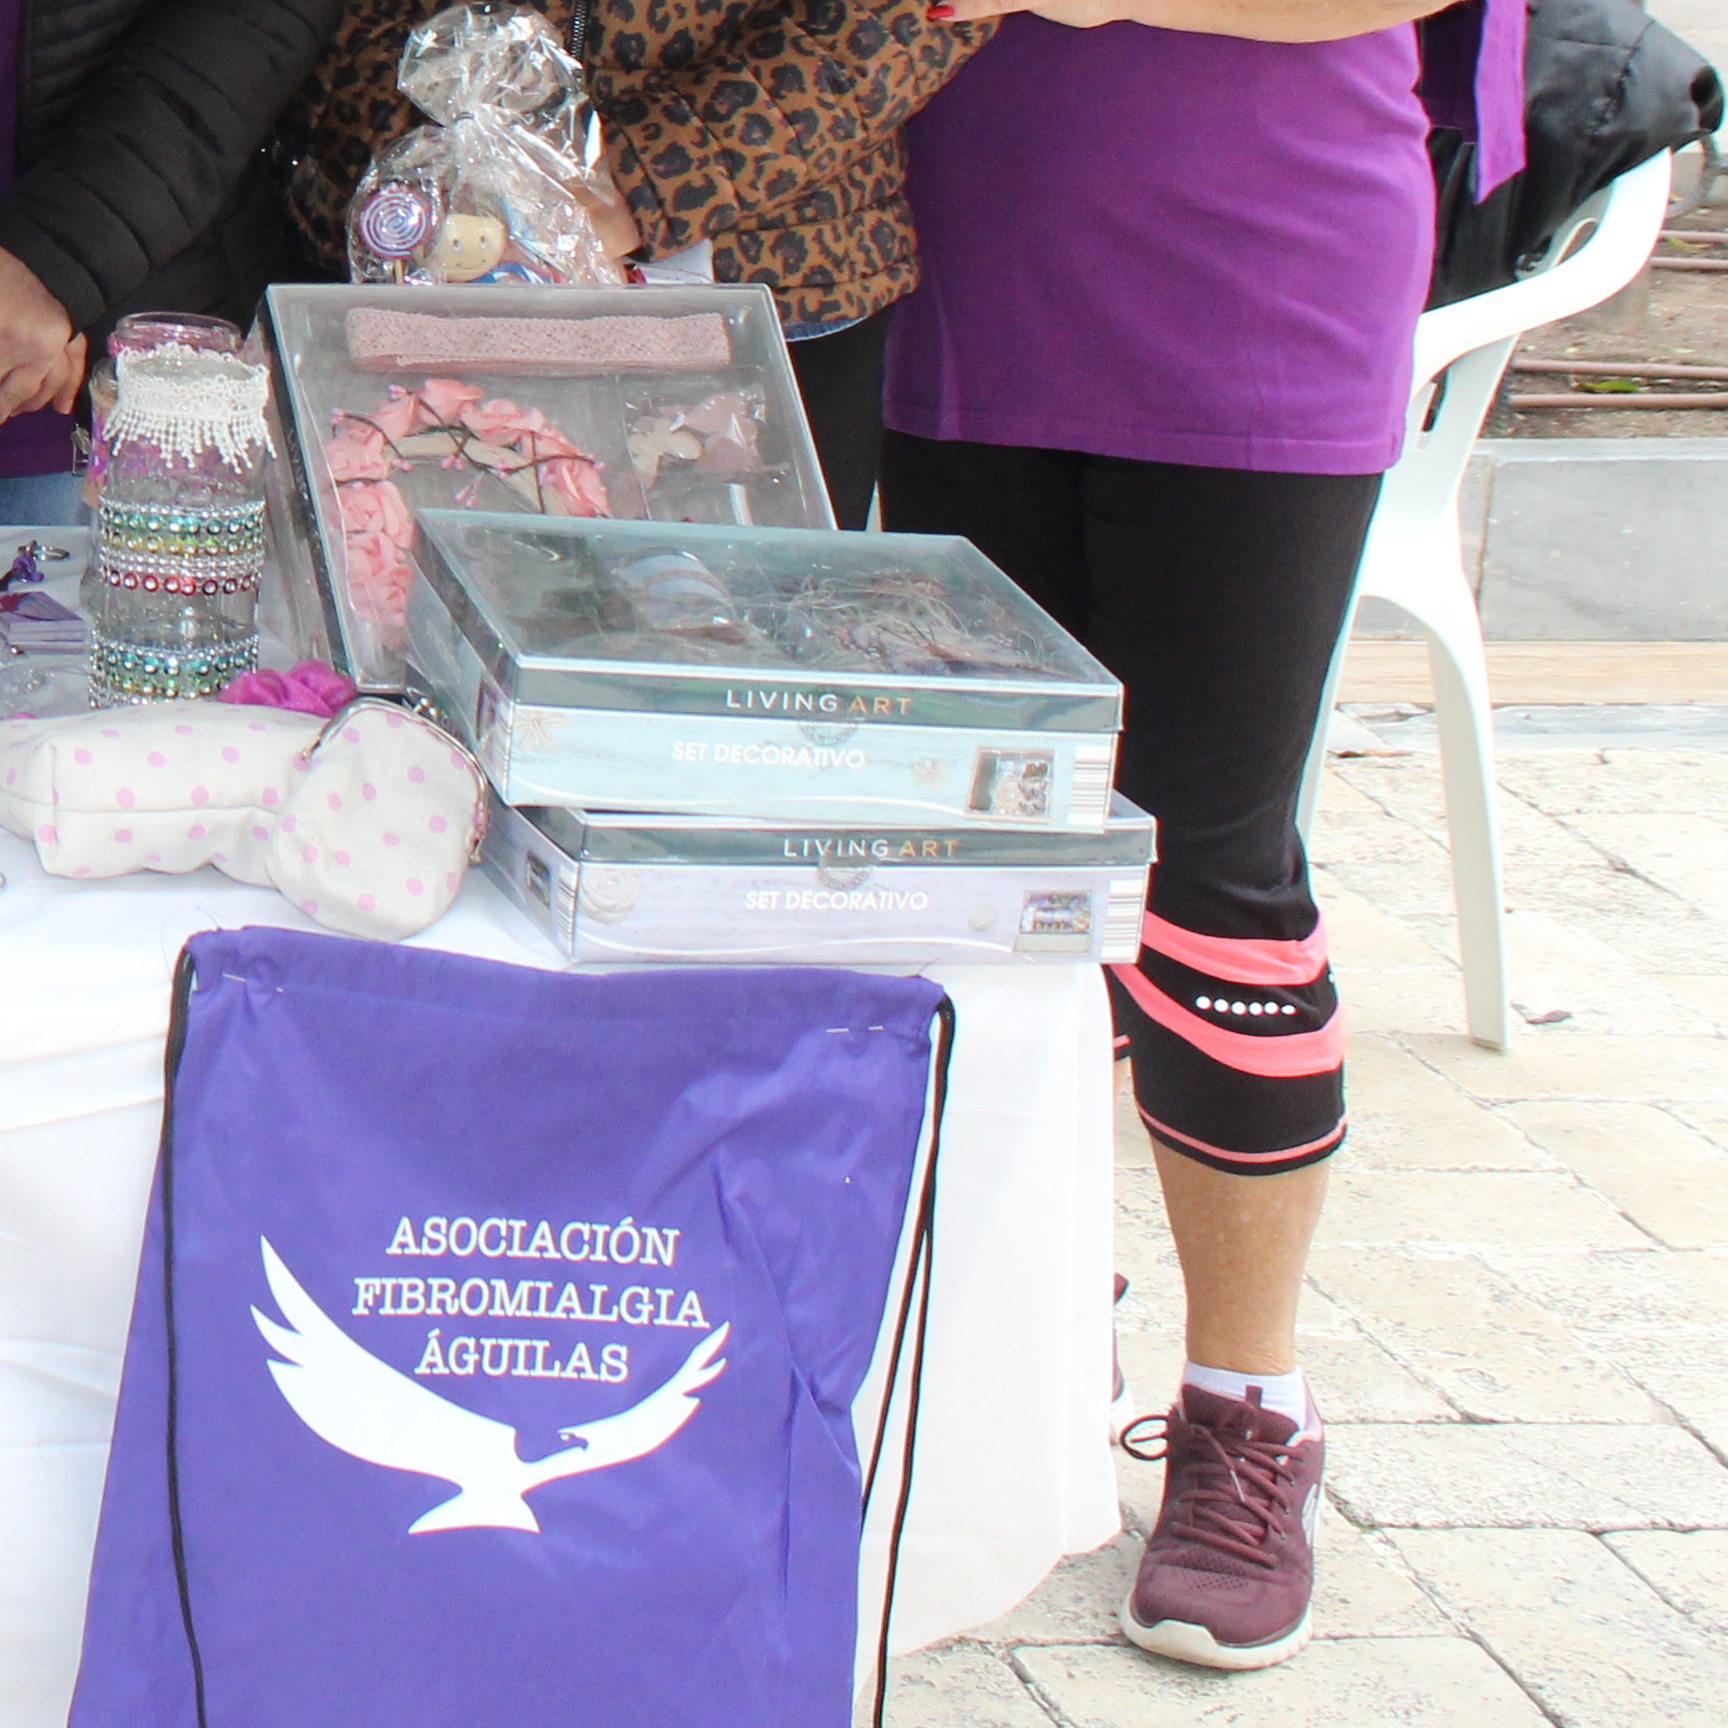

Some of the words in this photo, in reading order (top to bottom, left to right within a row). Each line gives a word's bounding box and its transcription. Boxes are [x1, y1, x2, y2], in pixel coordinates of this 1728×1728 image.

[725, 688, 839, 714] LIVING
[848, 695, 914, 717] ART
[672, 741, 709, 762] SET
[713, 742, 868, 770] DECORATIVO
[783, 838, 890, 858] LIVING
[898, 838, 962, 858] ART
[744, 890, 782, 910] SET
[784, 890, 930, 911] DECORATIVO
[384, 1214, 681, 1268] ASOCIACIÓN
[350, 1276, 711, 1330] FIBROMIALGIA
[413, 1327, 630, 1384] ÁGUILAS
